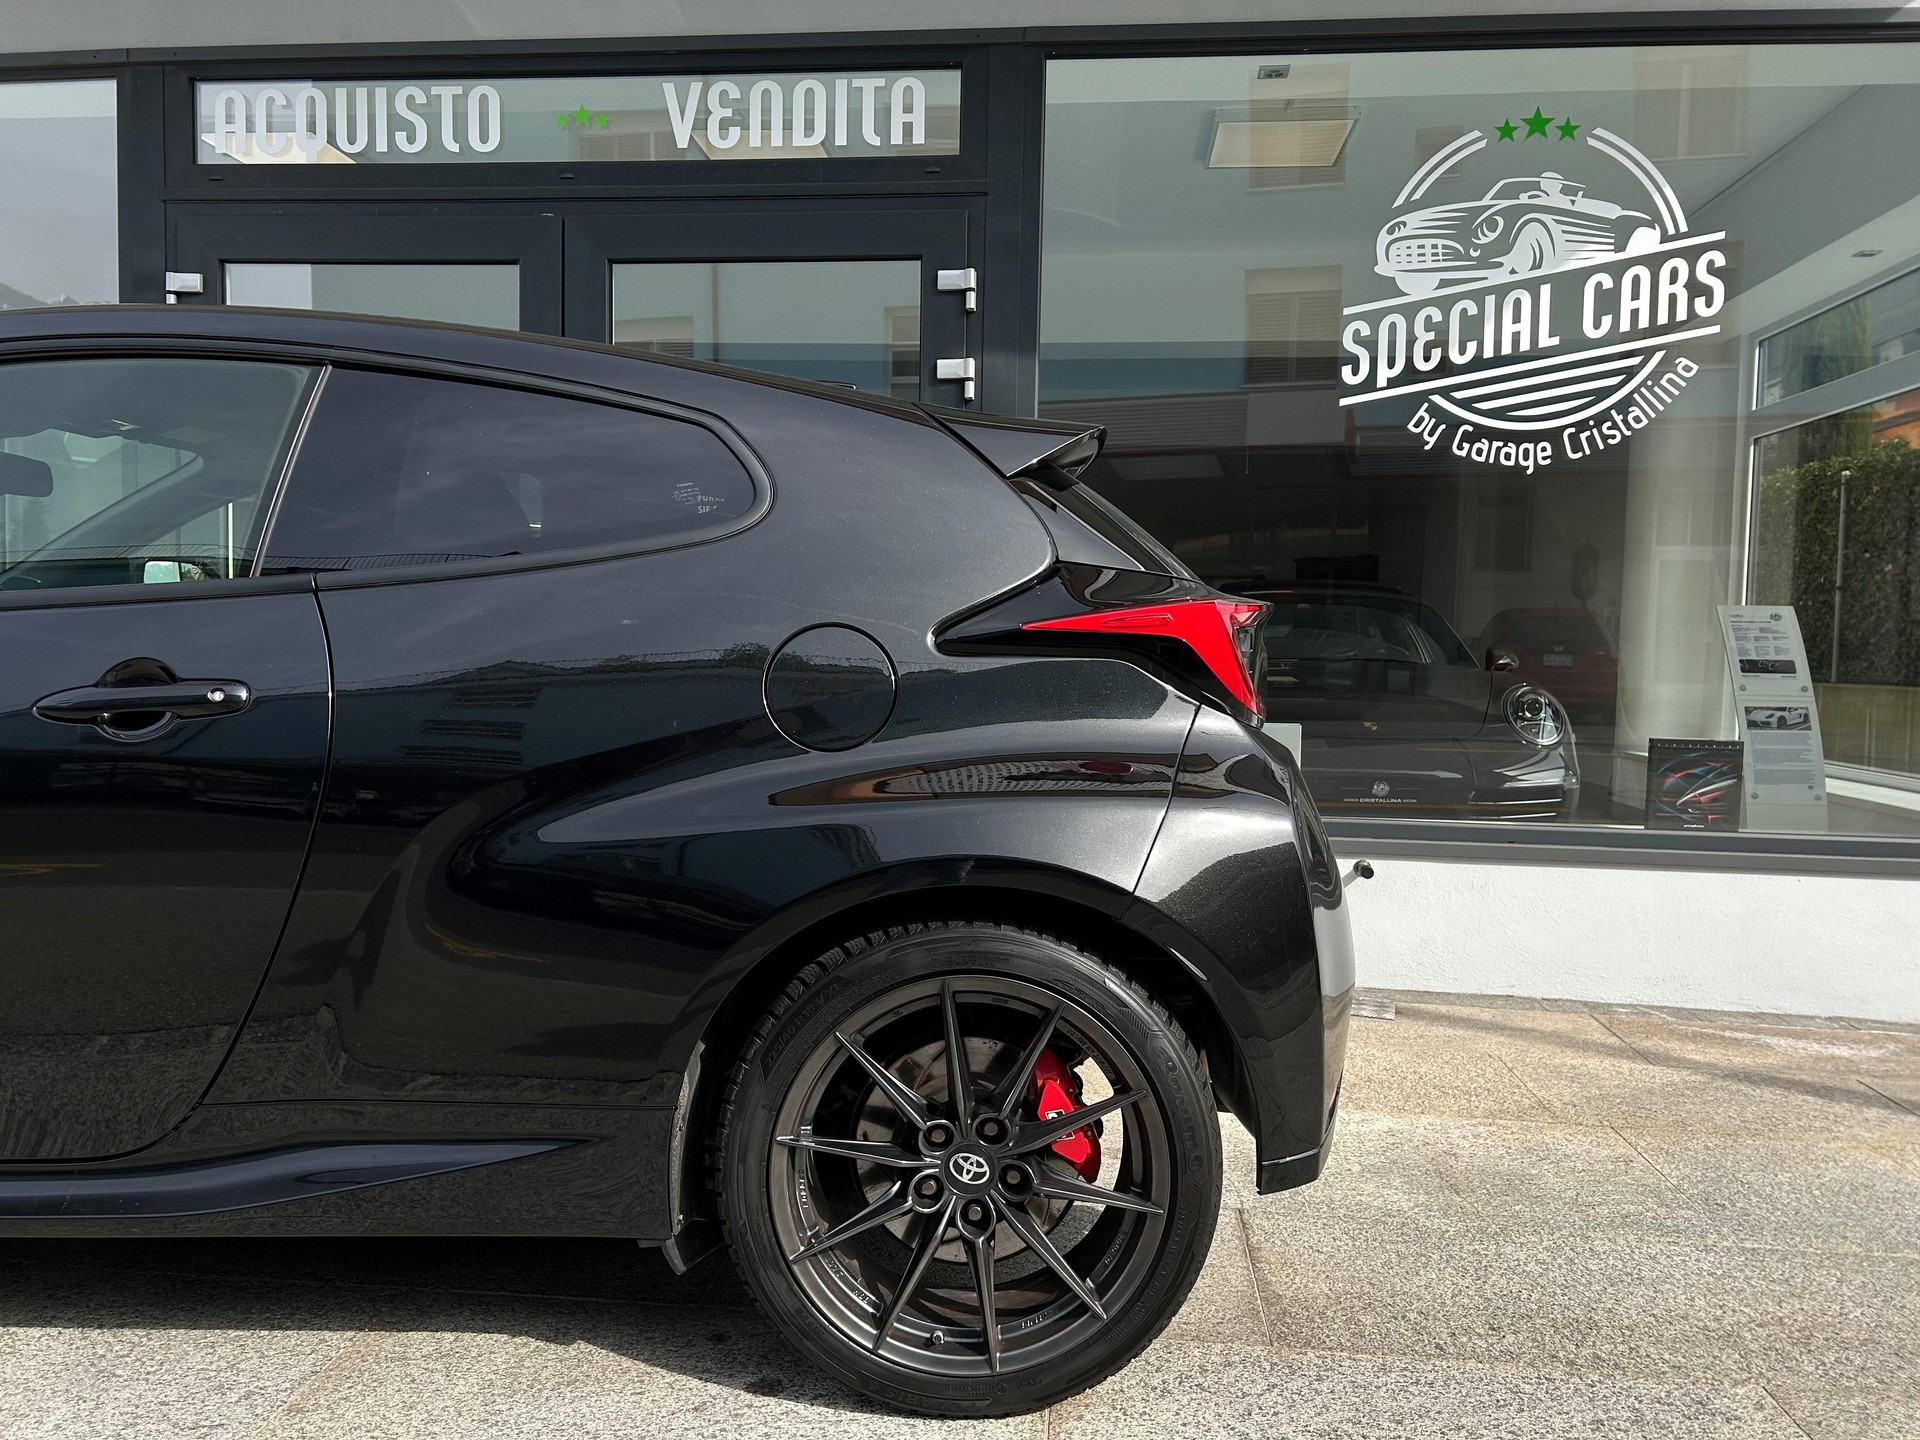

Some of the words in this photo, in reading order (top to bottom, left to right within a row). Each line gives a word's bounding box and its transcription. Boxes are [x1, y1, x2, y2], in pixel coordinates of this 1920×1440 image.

[213, 86, 501, 163] ACQUISTO
[662, 77, 926, 149] VENDITA
[1341, 282, 1560, 389] SPECIAL
[1582, 250, 1727, 339] CARS
[1406, 402, 1446, 450] by
[1452, 424, 1552, 475] Garage
[1562, 356, 1700, 460] Cristallina
[1155, 1043, 1200, 1150] Barum
